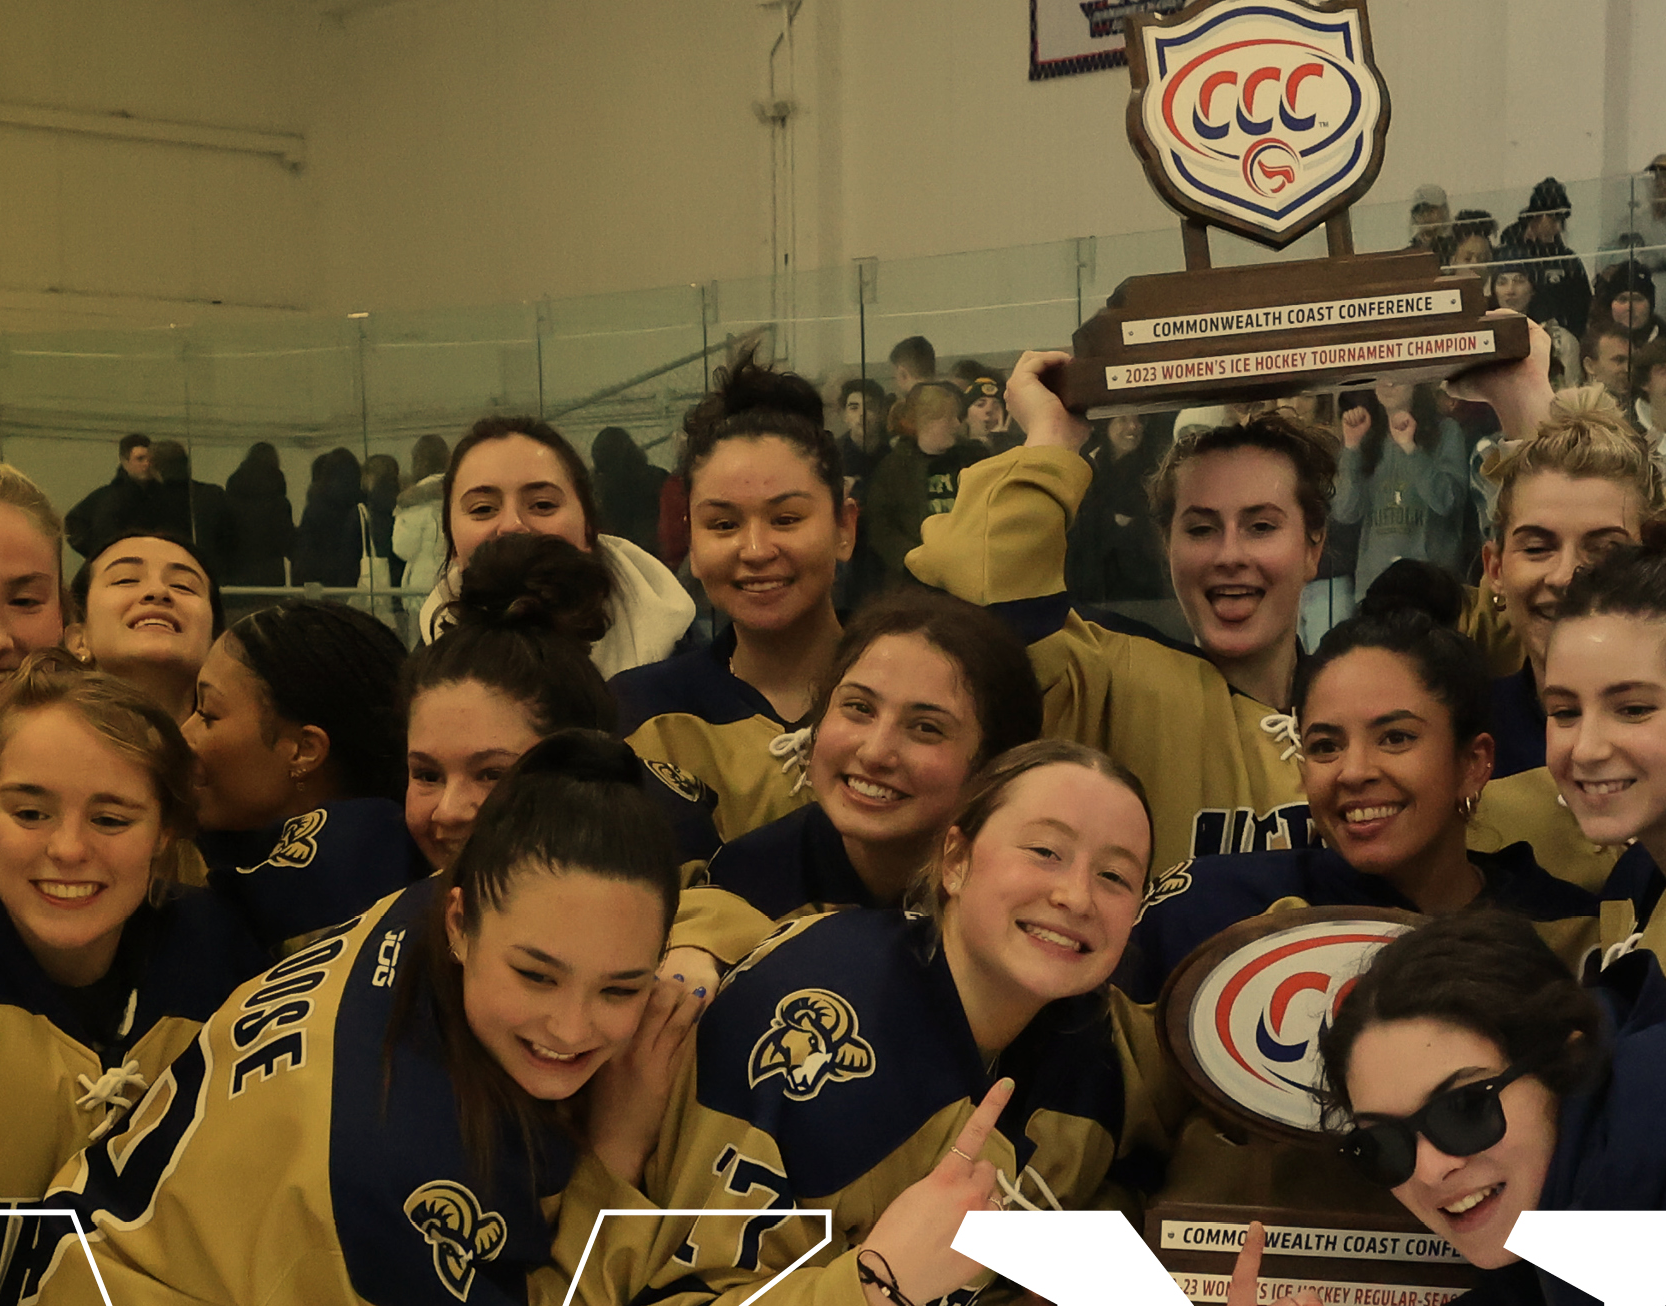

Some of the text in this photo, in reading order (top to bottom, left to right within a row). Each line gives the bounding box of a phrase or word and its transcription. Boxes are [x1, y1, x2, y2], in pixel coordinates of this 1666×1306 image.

[1192, 62, 1324, 140] CCC
[1152, 295, 1433, 338] COMMONWEALTH COAST CONFERENCE
[1125, 335, 1477, 384] 2023 WOMEN'S ICE HOCKEY TOURNAMENT CHAMPION
[1183, 1226, 1337, 1252] COMMOWEALTH
[1343, 1235, 1400, 1255] COAST
[1272, 1283, 1294, 1300] ICE
